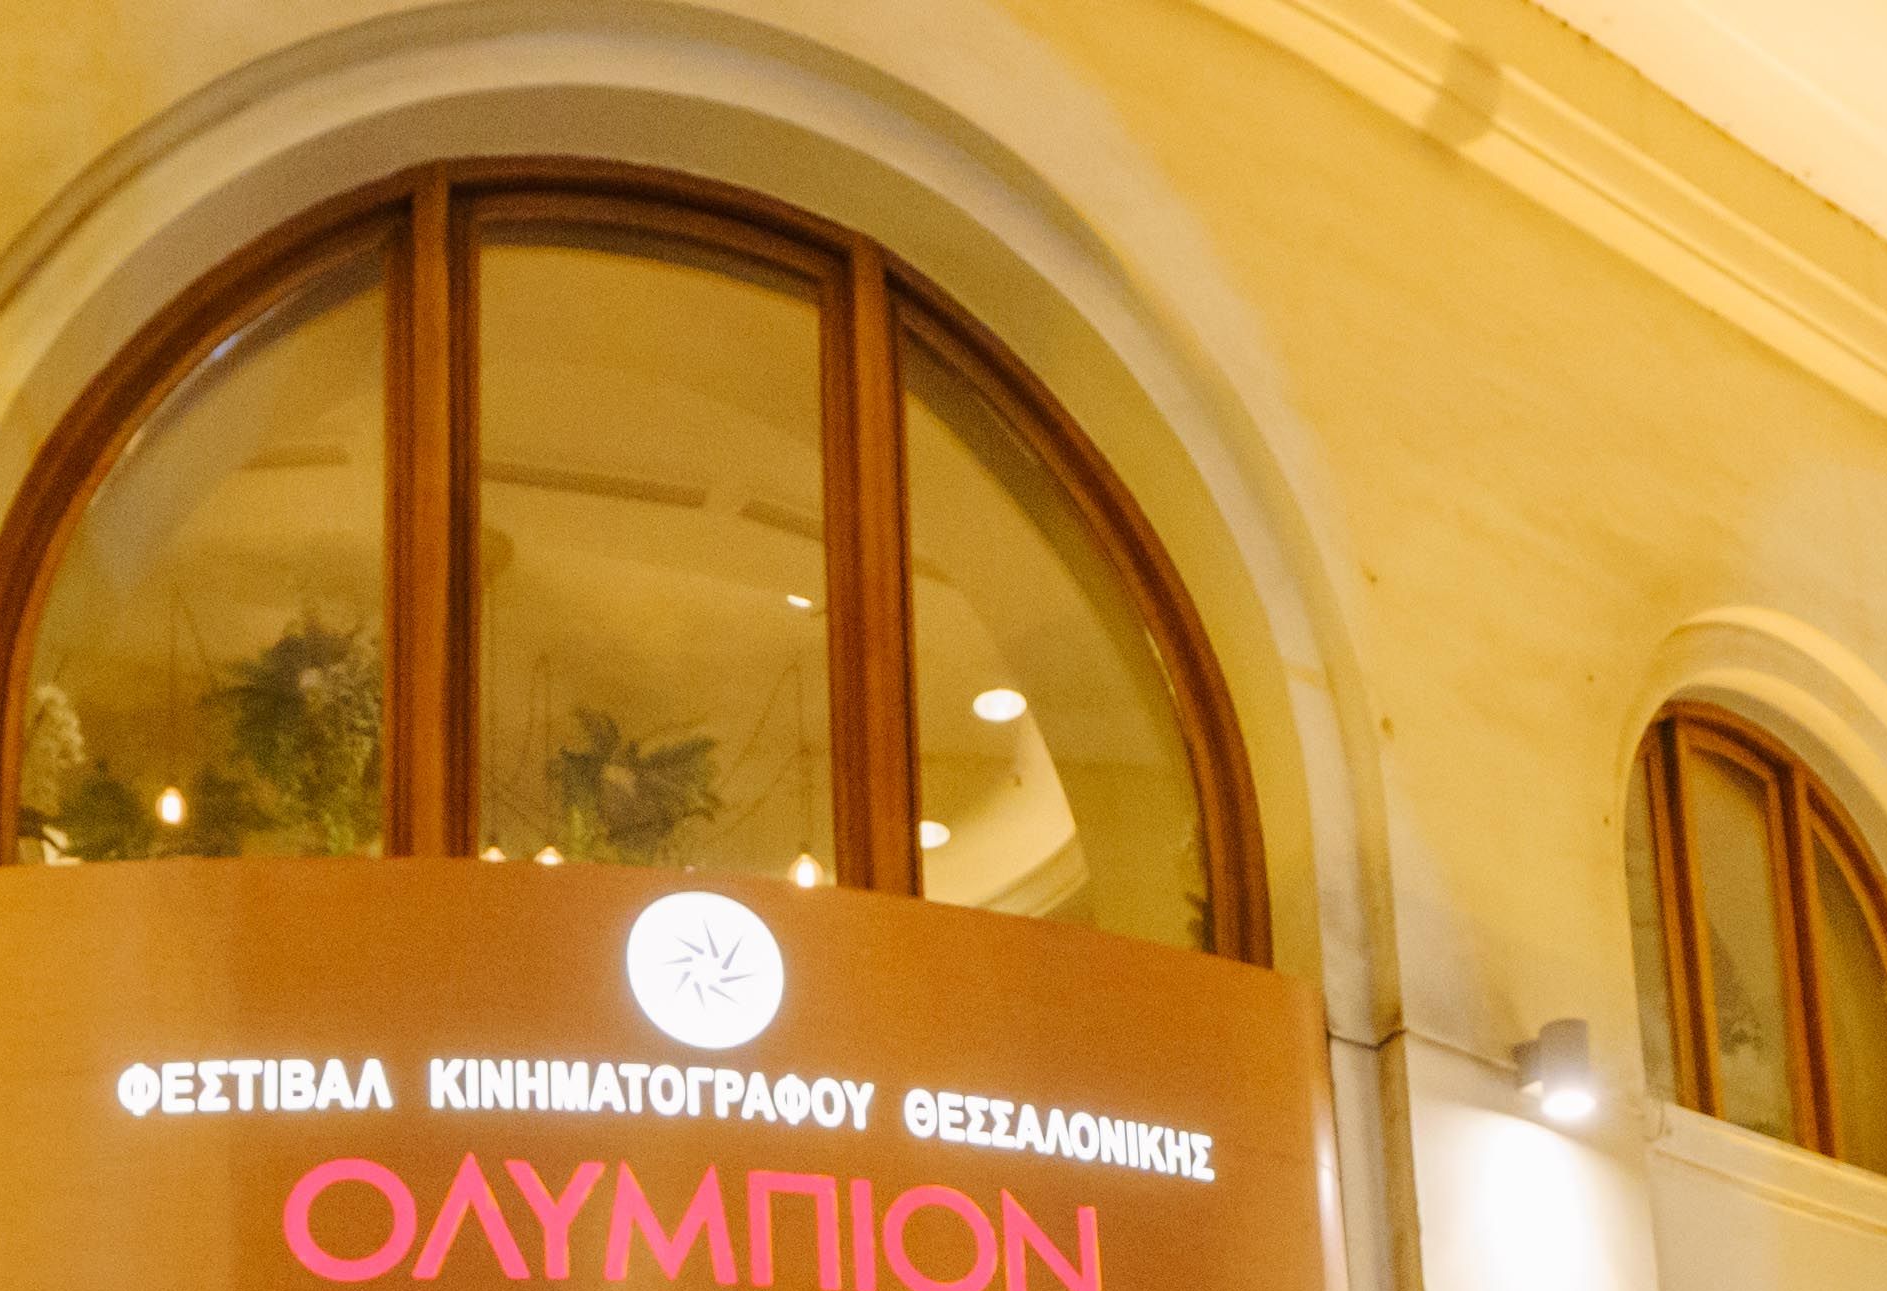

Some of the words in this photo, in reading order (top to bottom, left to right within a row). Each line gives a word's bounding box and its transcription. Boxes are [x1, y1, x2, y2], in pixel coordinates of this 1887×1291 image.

[117, 1058, 393, 1117] ΦΕΣΤΙΒΑΛ
[430, 1057, 875, 1130] ΚΙΝΗΜΑΤΟΓΡΑΦΟΥ
[904, 1088, 1215, 1181] ΘΕΣΣΑΛΟΝΙΚΗΣ
